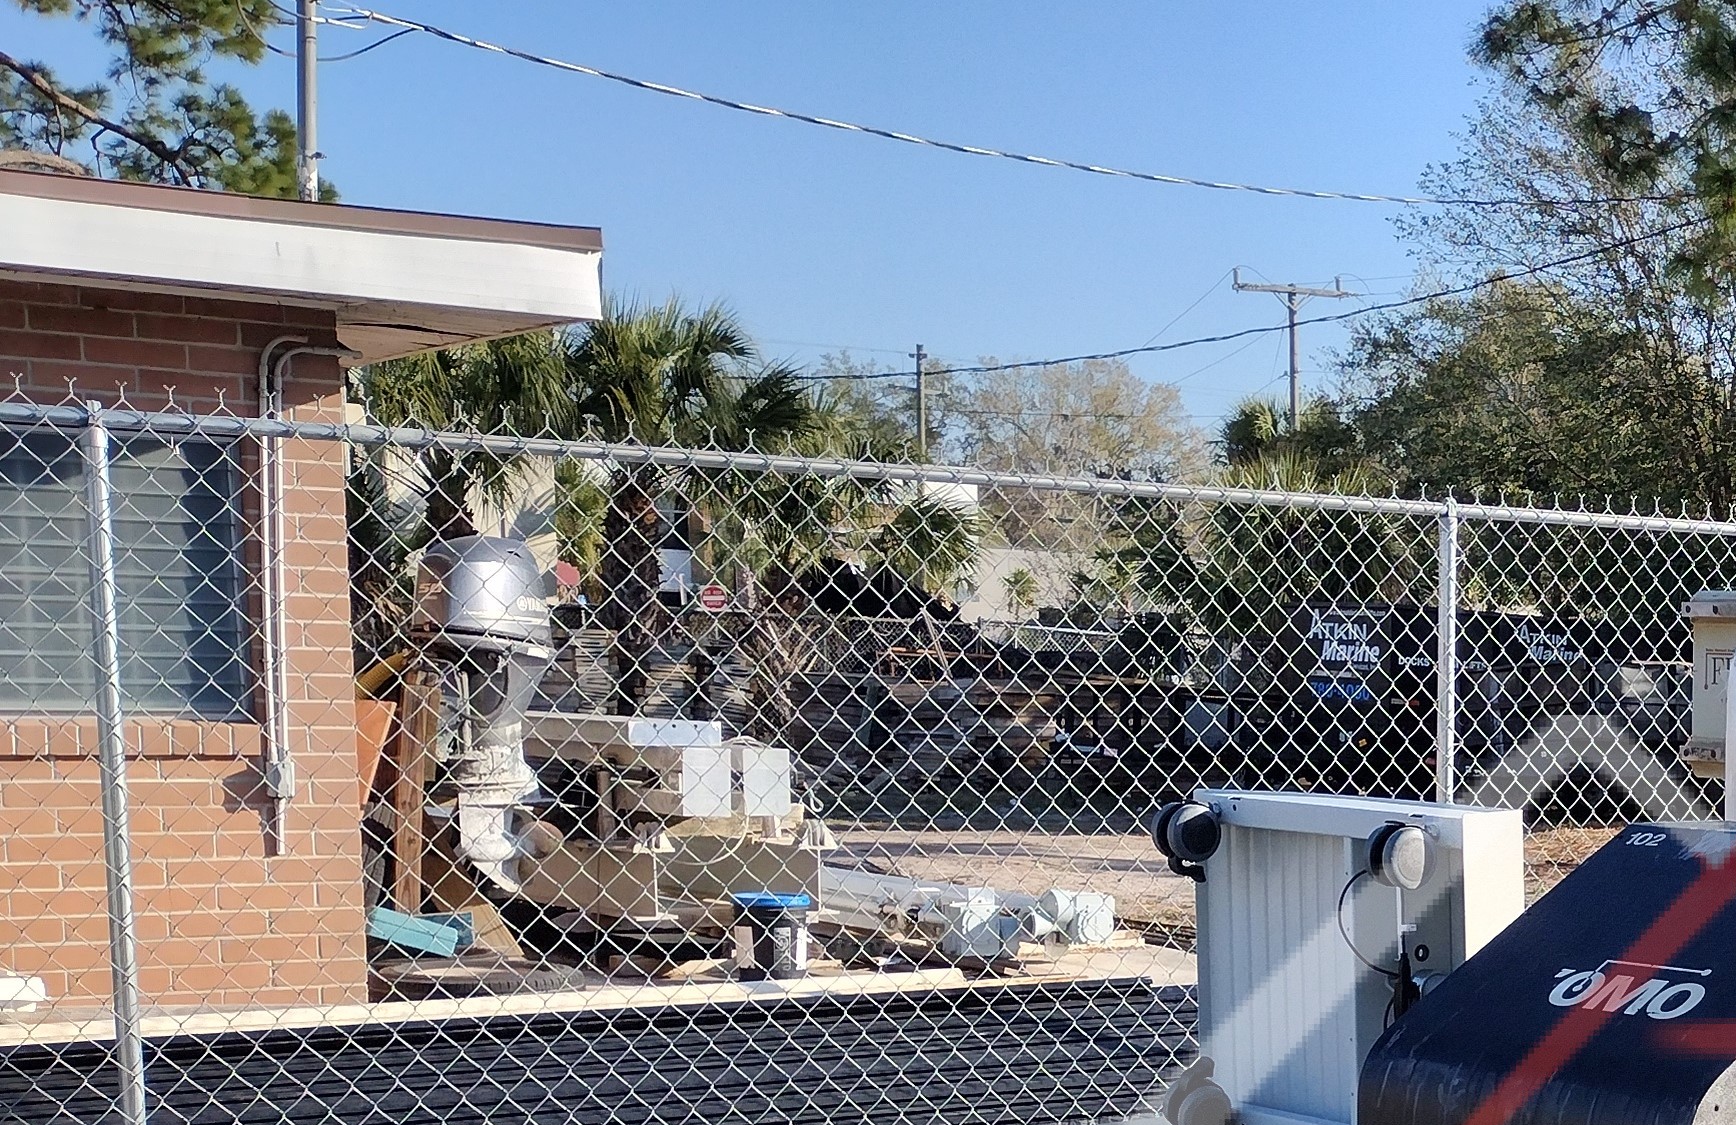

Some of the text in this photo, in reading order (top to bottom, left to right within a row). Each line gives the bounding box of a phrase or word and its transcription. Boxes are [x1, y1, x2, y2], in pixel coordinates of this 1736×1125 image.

[1309, 608, 1367, 641] ATKIN
[1321, 640, 1380, 662] Marine
[1398, 656, 1430, 667] DOCKS
[1625, 832, 1667, 847] 102
[1548, 968, 1706, 1020] OMO
